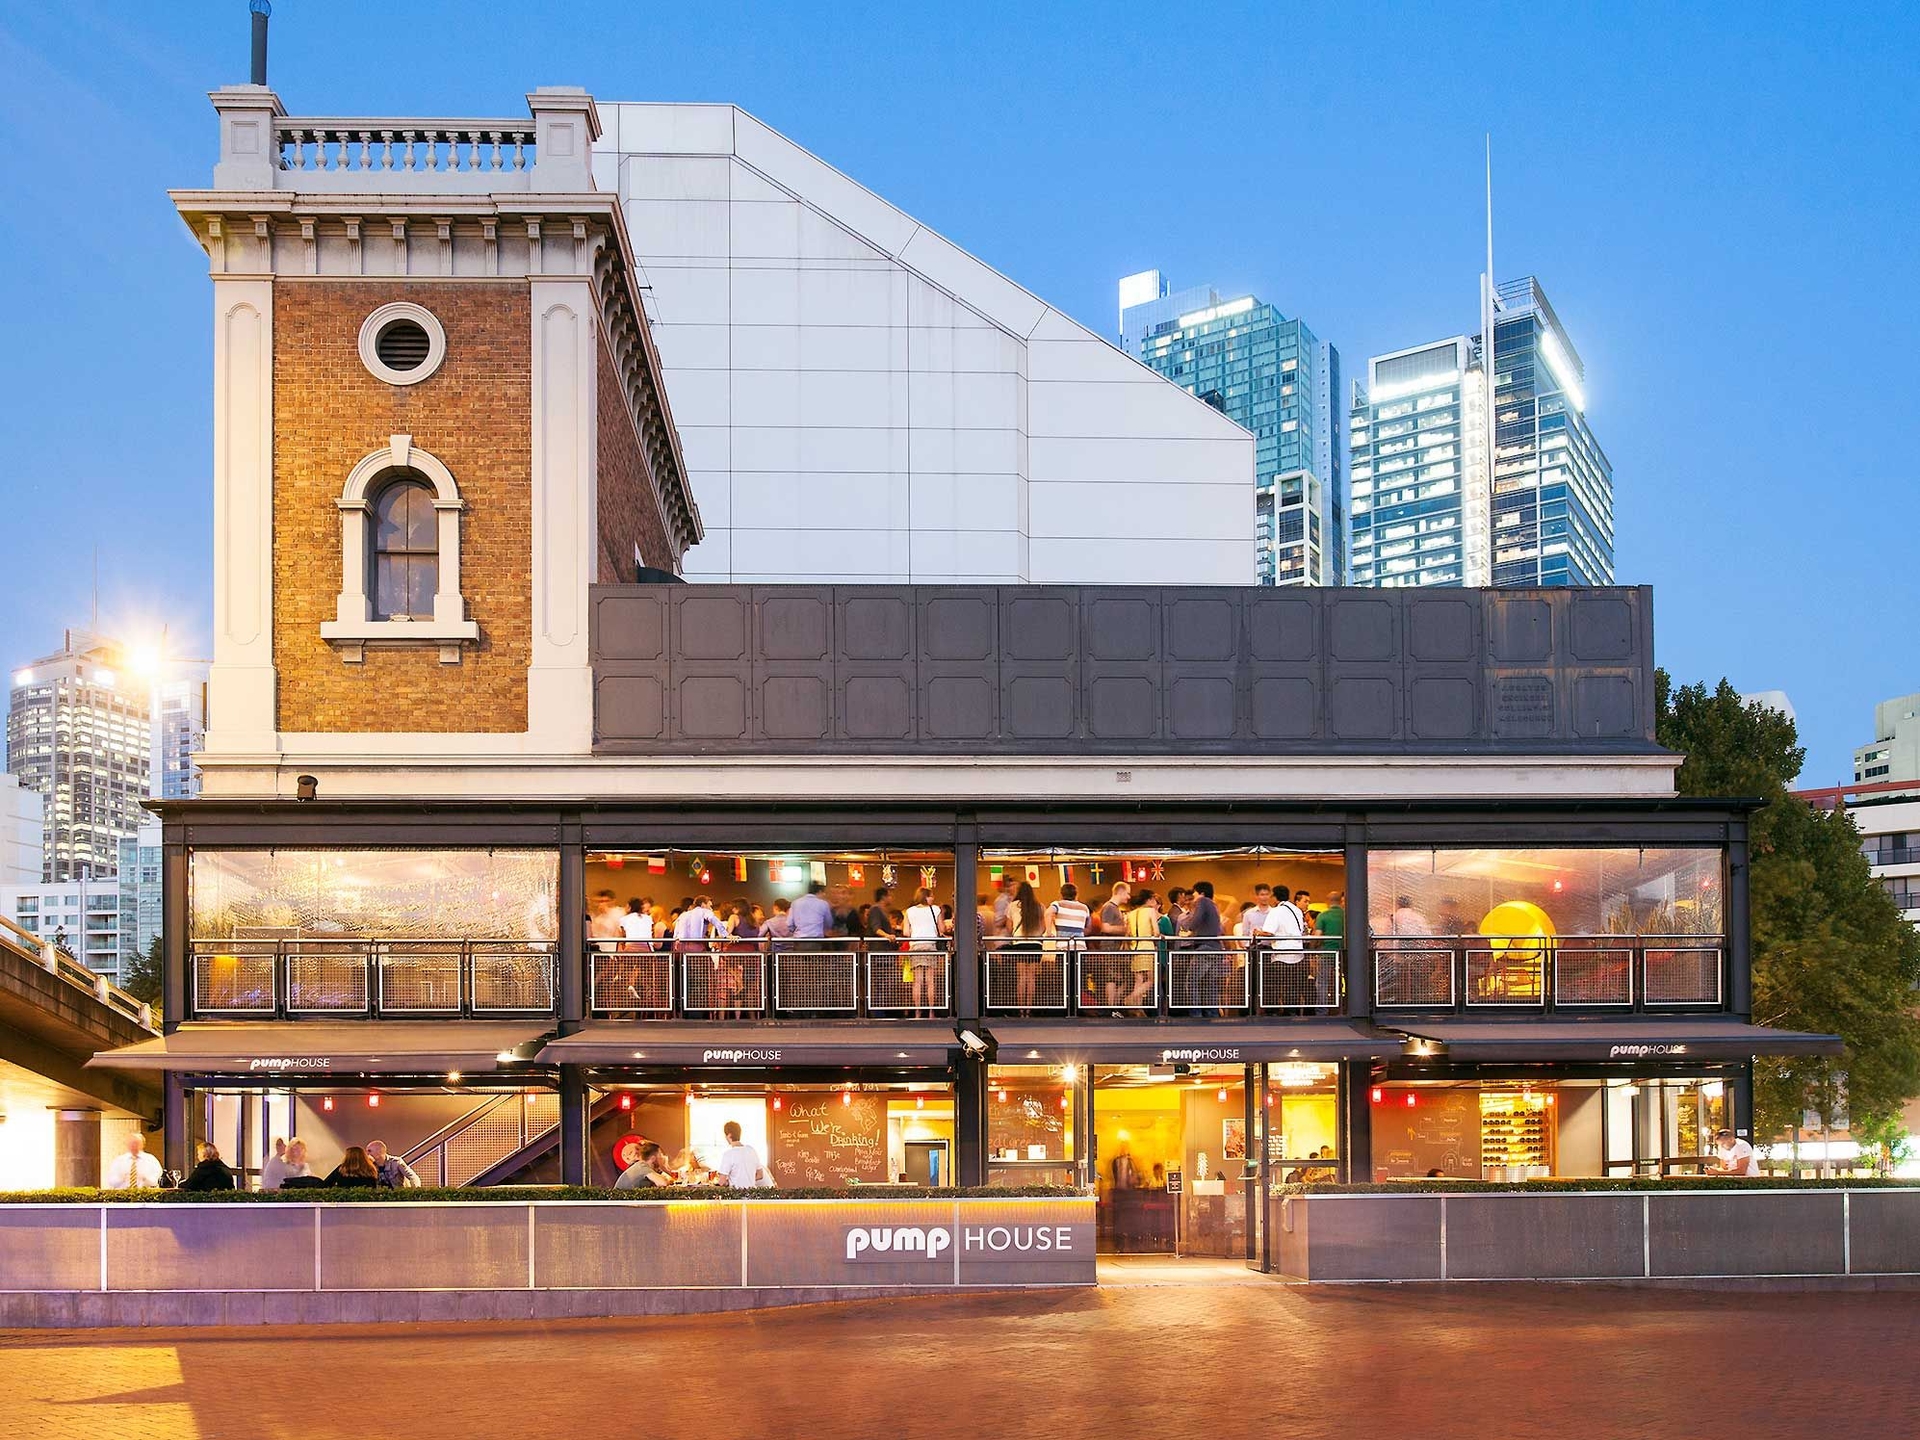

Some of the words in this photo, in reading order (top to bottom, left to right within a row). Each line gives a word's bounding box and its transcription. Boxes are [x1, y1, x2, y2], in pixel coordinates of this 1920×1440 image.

[789, 1102, 829, 1118] What
[810, 1120, 842, 1133] We're
[846, 1227, 951, 1259] pump
[965, 1227, 1073, 1251] HOUSE
